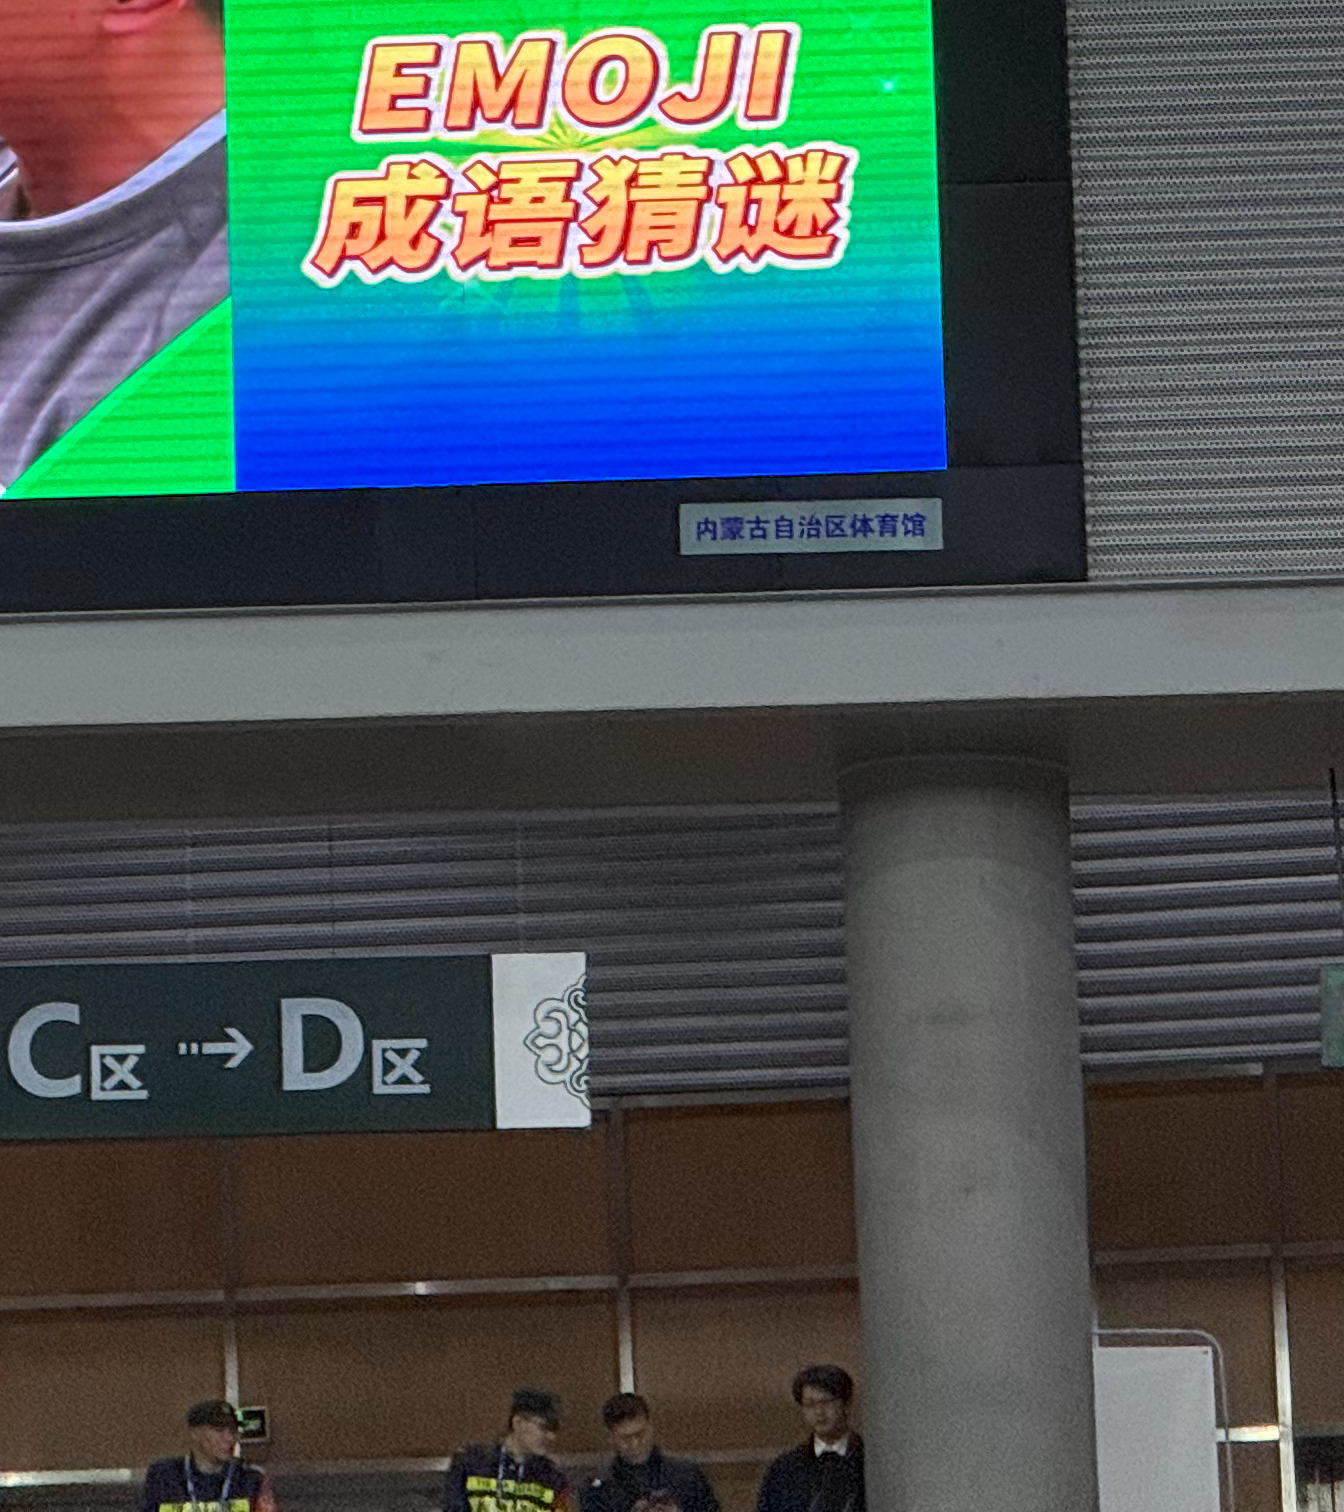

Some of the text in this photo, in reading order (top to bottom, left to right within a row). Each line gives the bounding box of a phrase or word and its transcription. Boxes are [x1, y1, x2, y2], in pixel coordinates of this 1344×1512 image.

[357, 25, 799, 139] EMOJI
[305, 143, 856, 286] 成语猜谜
[695, 512, 927, 542] 内蒙古自治区体育馆
[6, 1001, 148, 1102] C区
[279, 996, 431, 1096] D区
